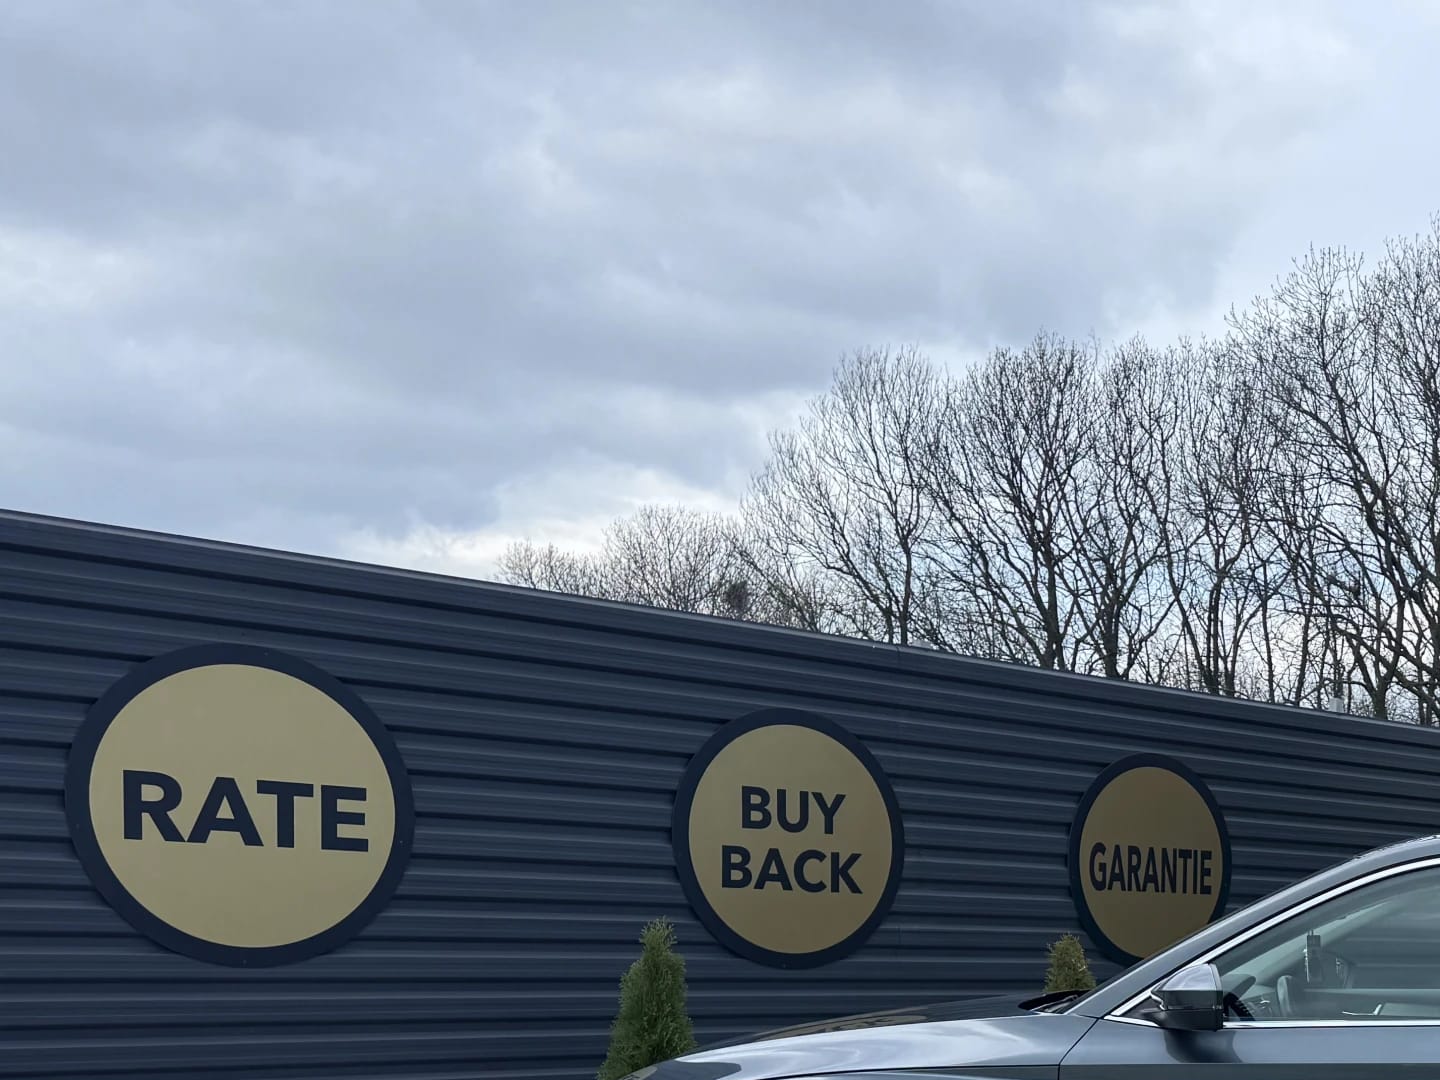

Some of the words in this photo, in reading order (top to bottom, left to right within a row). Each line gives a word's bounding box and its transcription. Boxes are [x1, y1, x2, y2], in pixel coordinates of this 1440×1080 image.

[121, 769, 369, 852] RATE
[741, 785, 846, 835] BUY
[721, 844, 863, 894] BACK
[1088, 841, 1213, 895] GARANTIE
